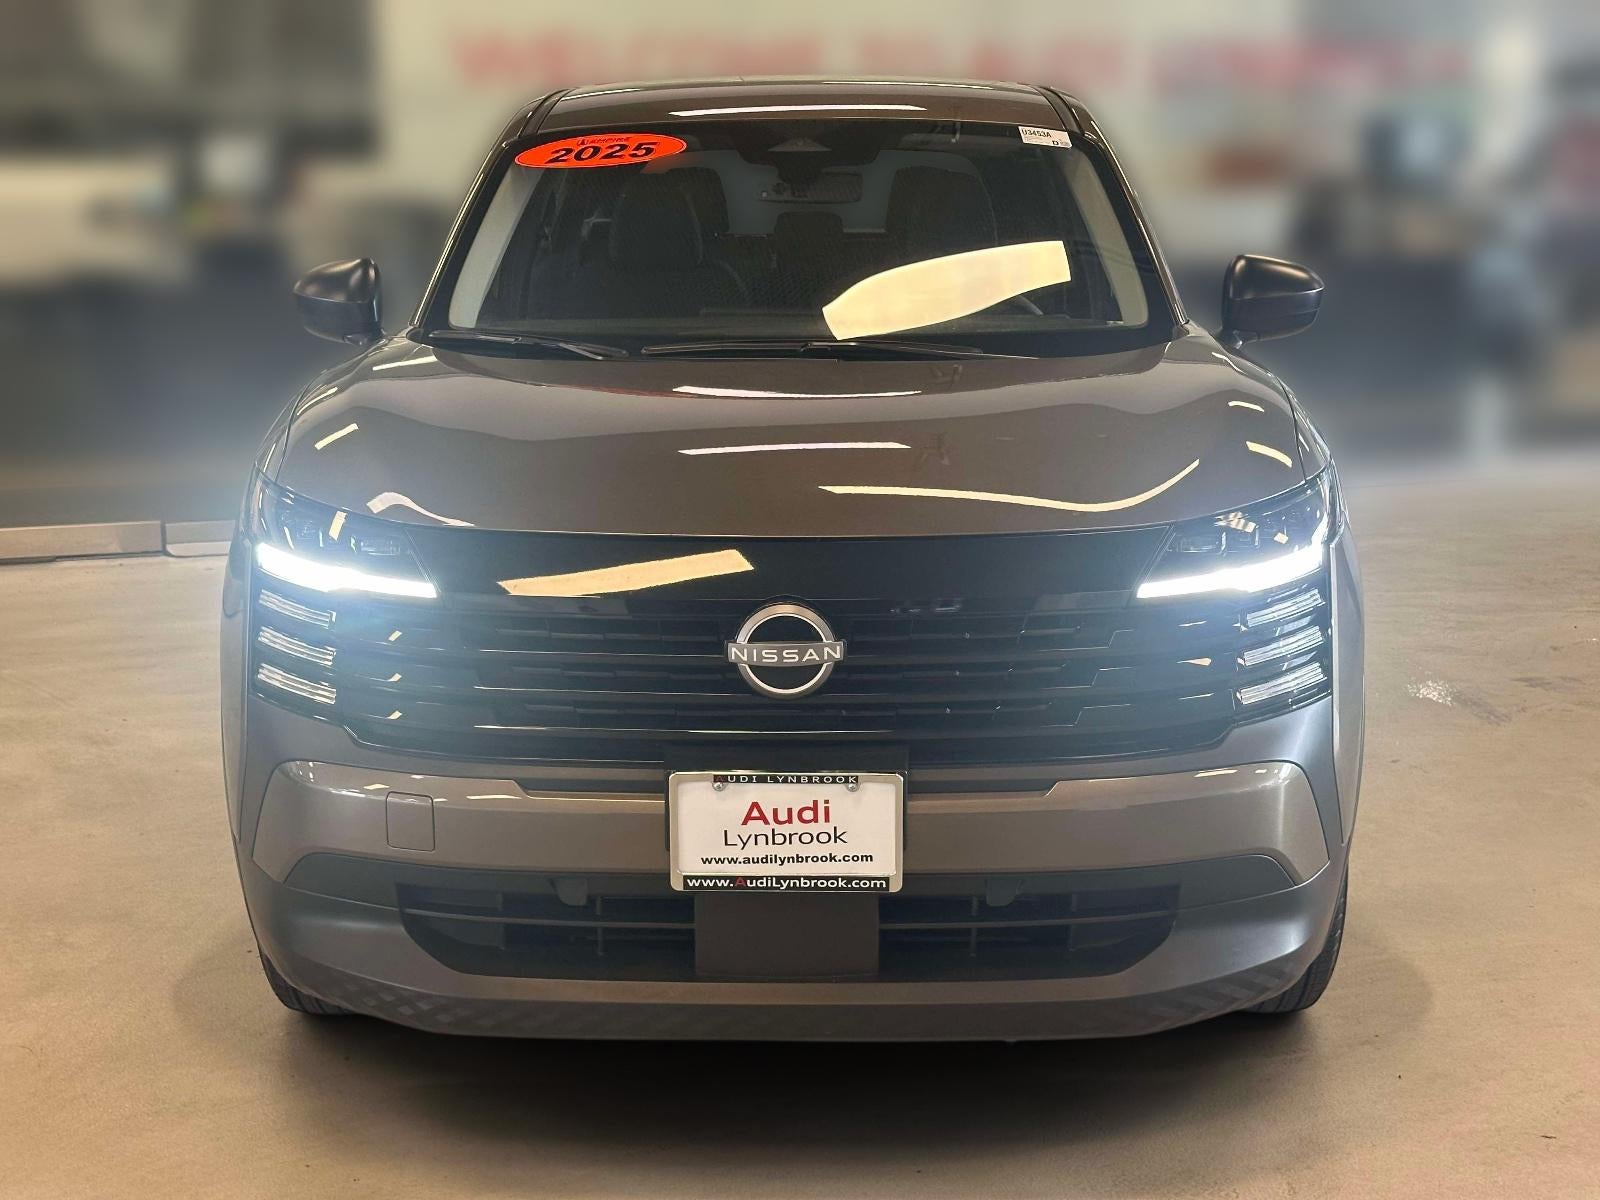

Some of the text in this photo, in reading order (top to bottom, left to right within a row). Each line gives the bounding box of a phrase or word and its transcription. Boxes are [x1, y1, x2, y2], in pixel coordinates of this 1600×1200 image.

[545, 141, 659, 164] 2025
[731, 646, 841, 663] NISSAN
[714, 775, 858, 784] AUDI LYNBROOK
[741, 800, 831, 826] Audi
[723, 826, 848, 850] Lynbrook
[701, 852, 874, 866] www.audilynbrook.com
[687, 876, 887, 890] www.AudiLynbrook.com
